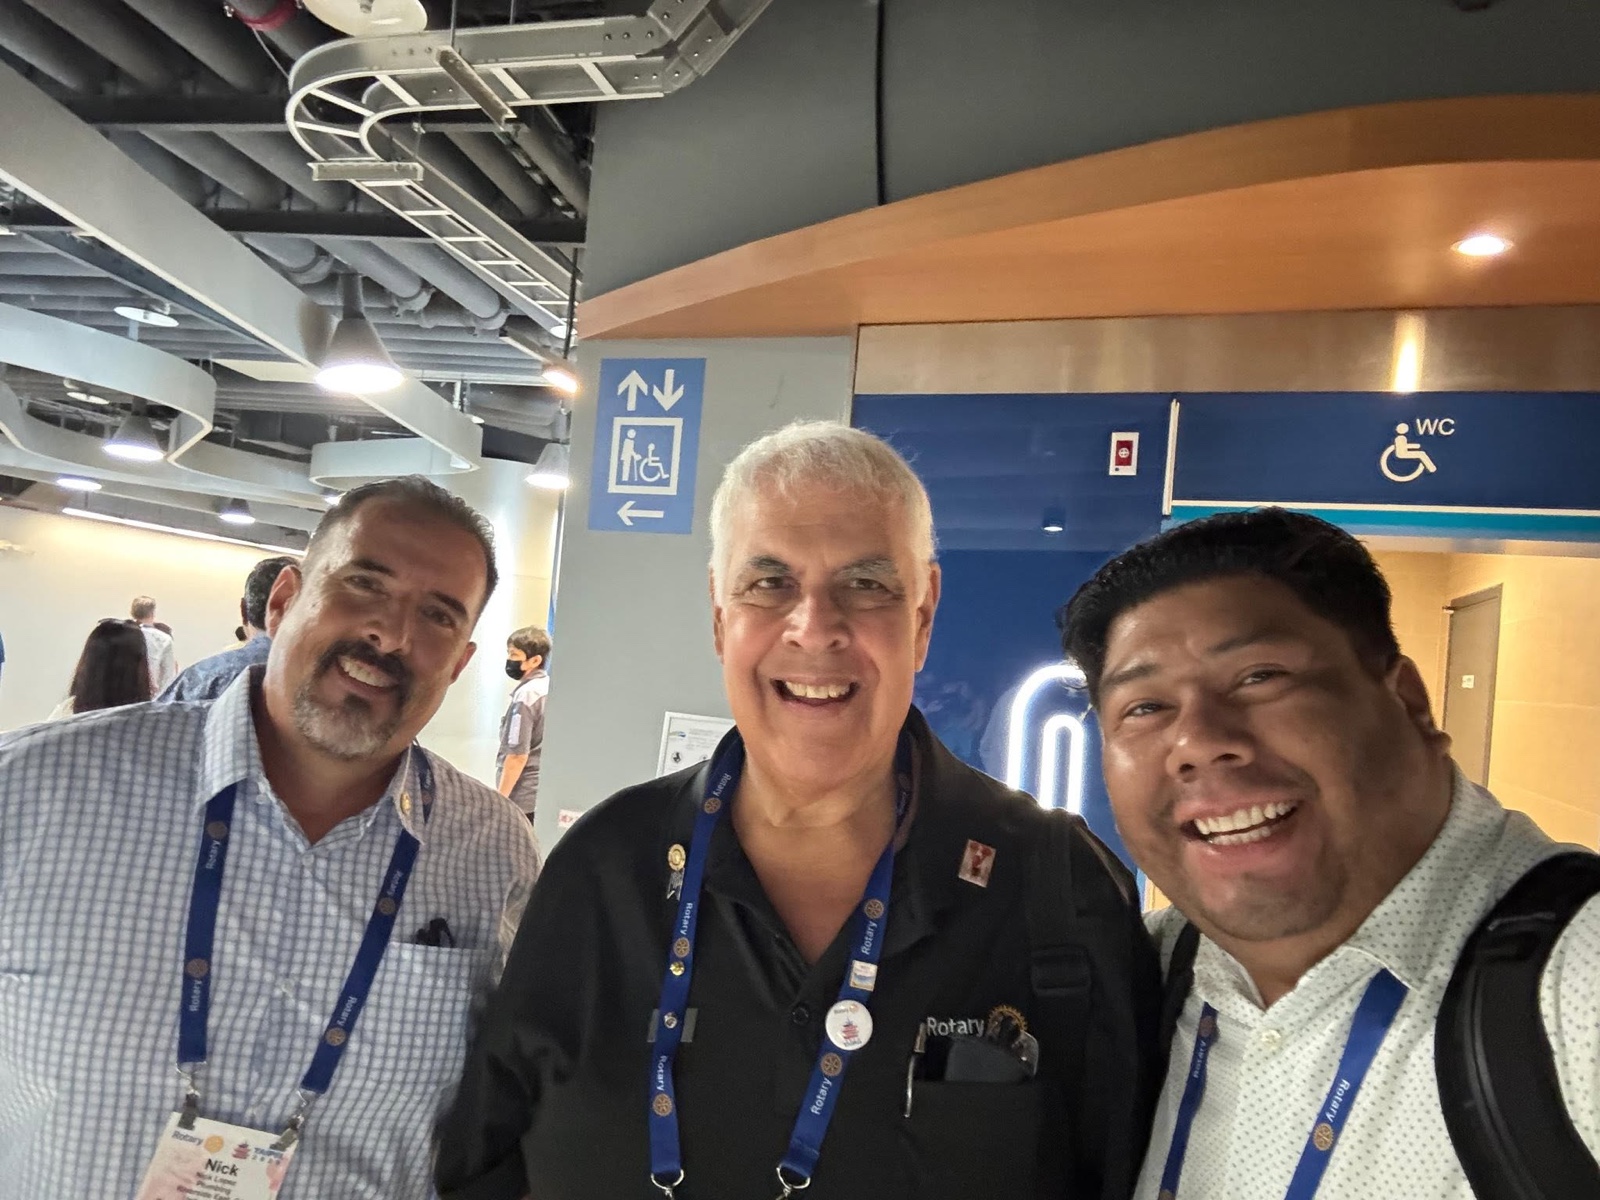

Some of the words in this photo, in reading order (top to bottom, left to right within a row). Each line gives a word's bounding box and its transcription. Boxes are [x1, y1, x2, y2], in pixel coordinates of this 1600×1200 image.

[1416, 437, 1455, 456] WC
[712, 773, 732, 797] Rotary
[205, 839, 221, 870] Rotary
[679, 901, 694, 936] Rotary
[860, 920, 878, 956] Rotary
[189, 979, 203, 1012] Rotary
[335, 995, 358, 1026] Rotary
[926, 1016, 985, 1038] Rotary
[657, 1055, 669, 1092] Rotary
[1192, 1040, 1207, 1079] Rotary
[810, 1077, 833, 1116] Rotary
[1326, 1079, 1350, 1123] Rotary
[172, 1130, 203, 1146] Rotary
[205, 1158, 240, 1177] Nick
